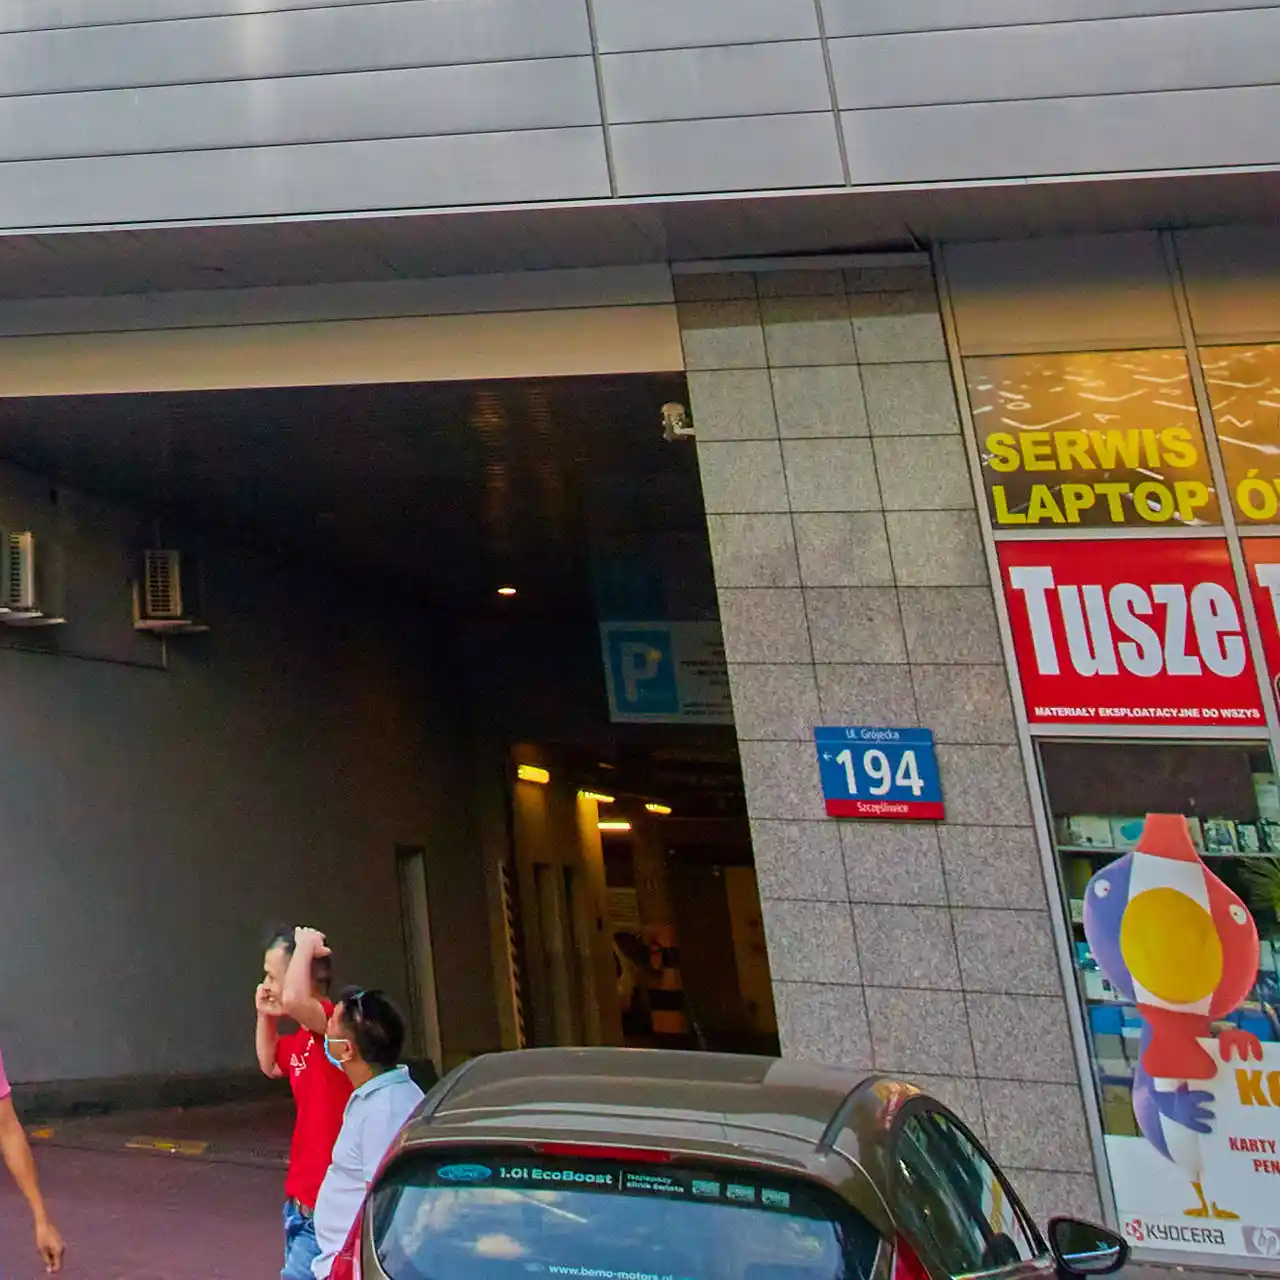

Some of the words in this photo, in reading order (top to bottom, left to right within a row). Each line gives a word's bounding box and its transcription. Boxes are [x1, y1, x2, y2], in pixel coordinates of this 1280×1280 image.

[985, 427, 1197, 473] SERWIS
[992, 481, 1208, 524] LAPTOP
[1008, 566, 1247, 677] Tusze
[1035, 707, 1096, 717] MATERIAŁY
[1098, 707, 1200, 719] EKSPLOATACYJNE
[1203, 708, 1218, 718] DO
[860, 728, 900, 744] Grójecka
[836, 749, 925, 796] 194
[856, 802, 909, 814] Szczęśliwice
[1228, 1136, 1276, 1154] KARTY
[531, 1169, 613, 1184] EcoBoost
[1146, 1224, 1225, 1245] KYOCERA
